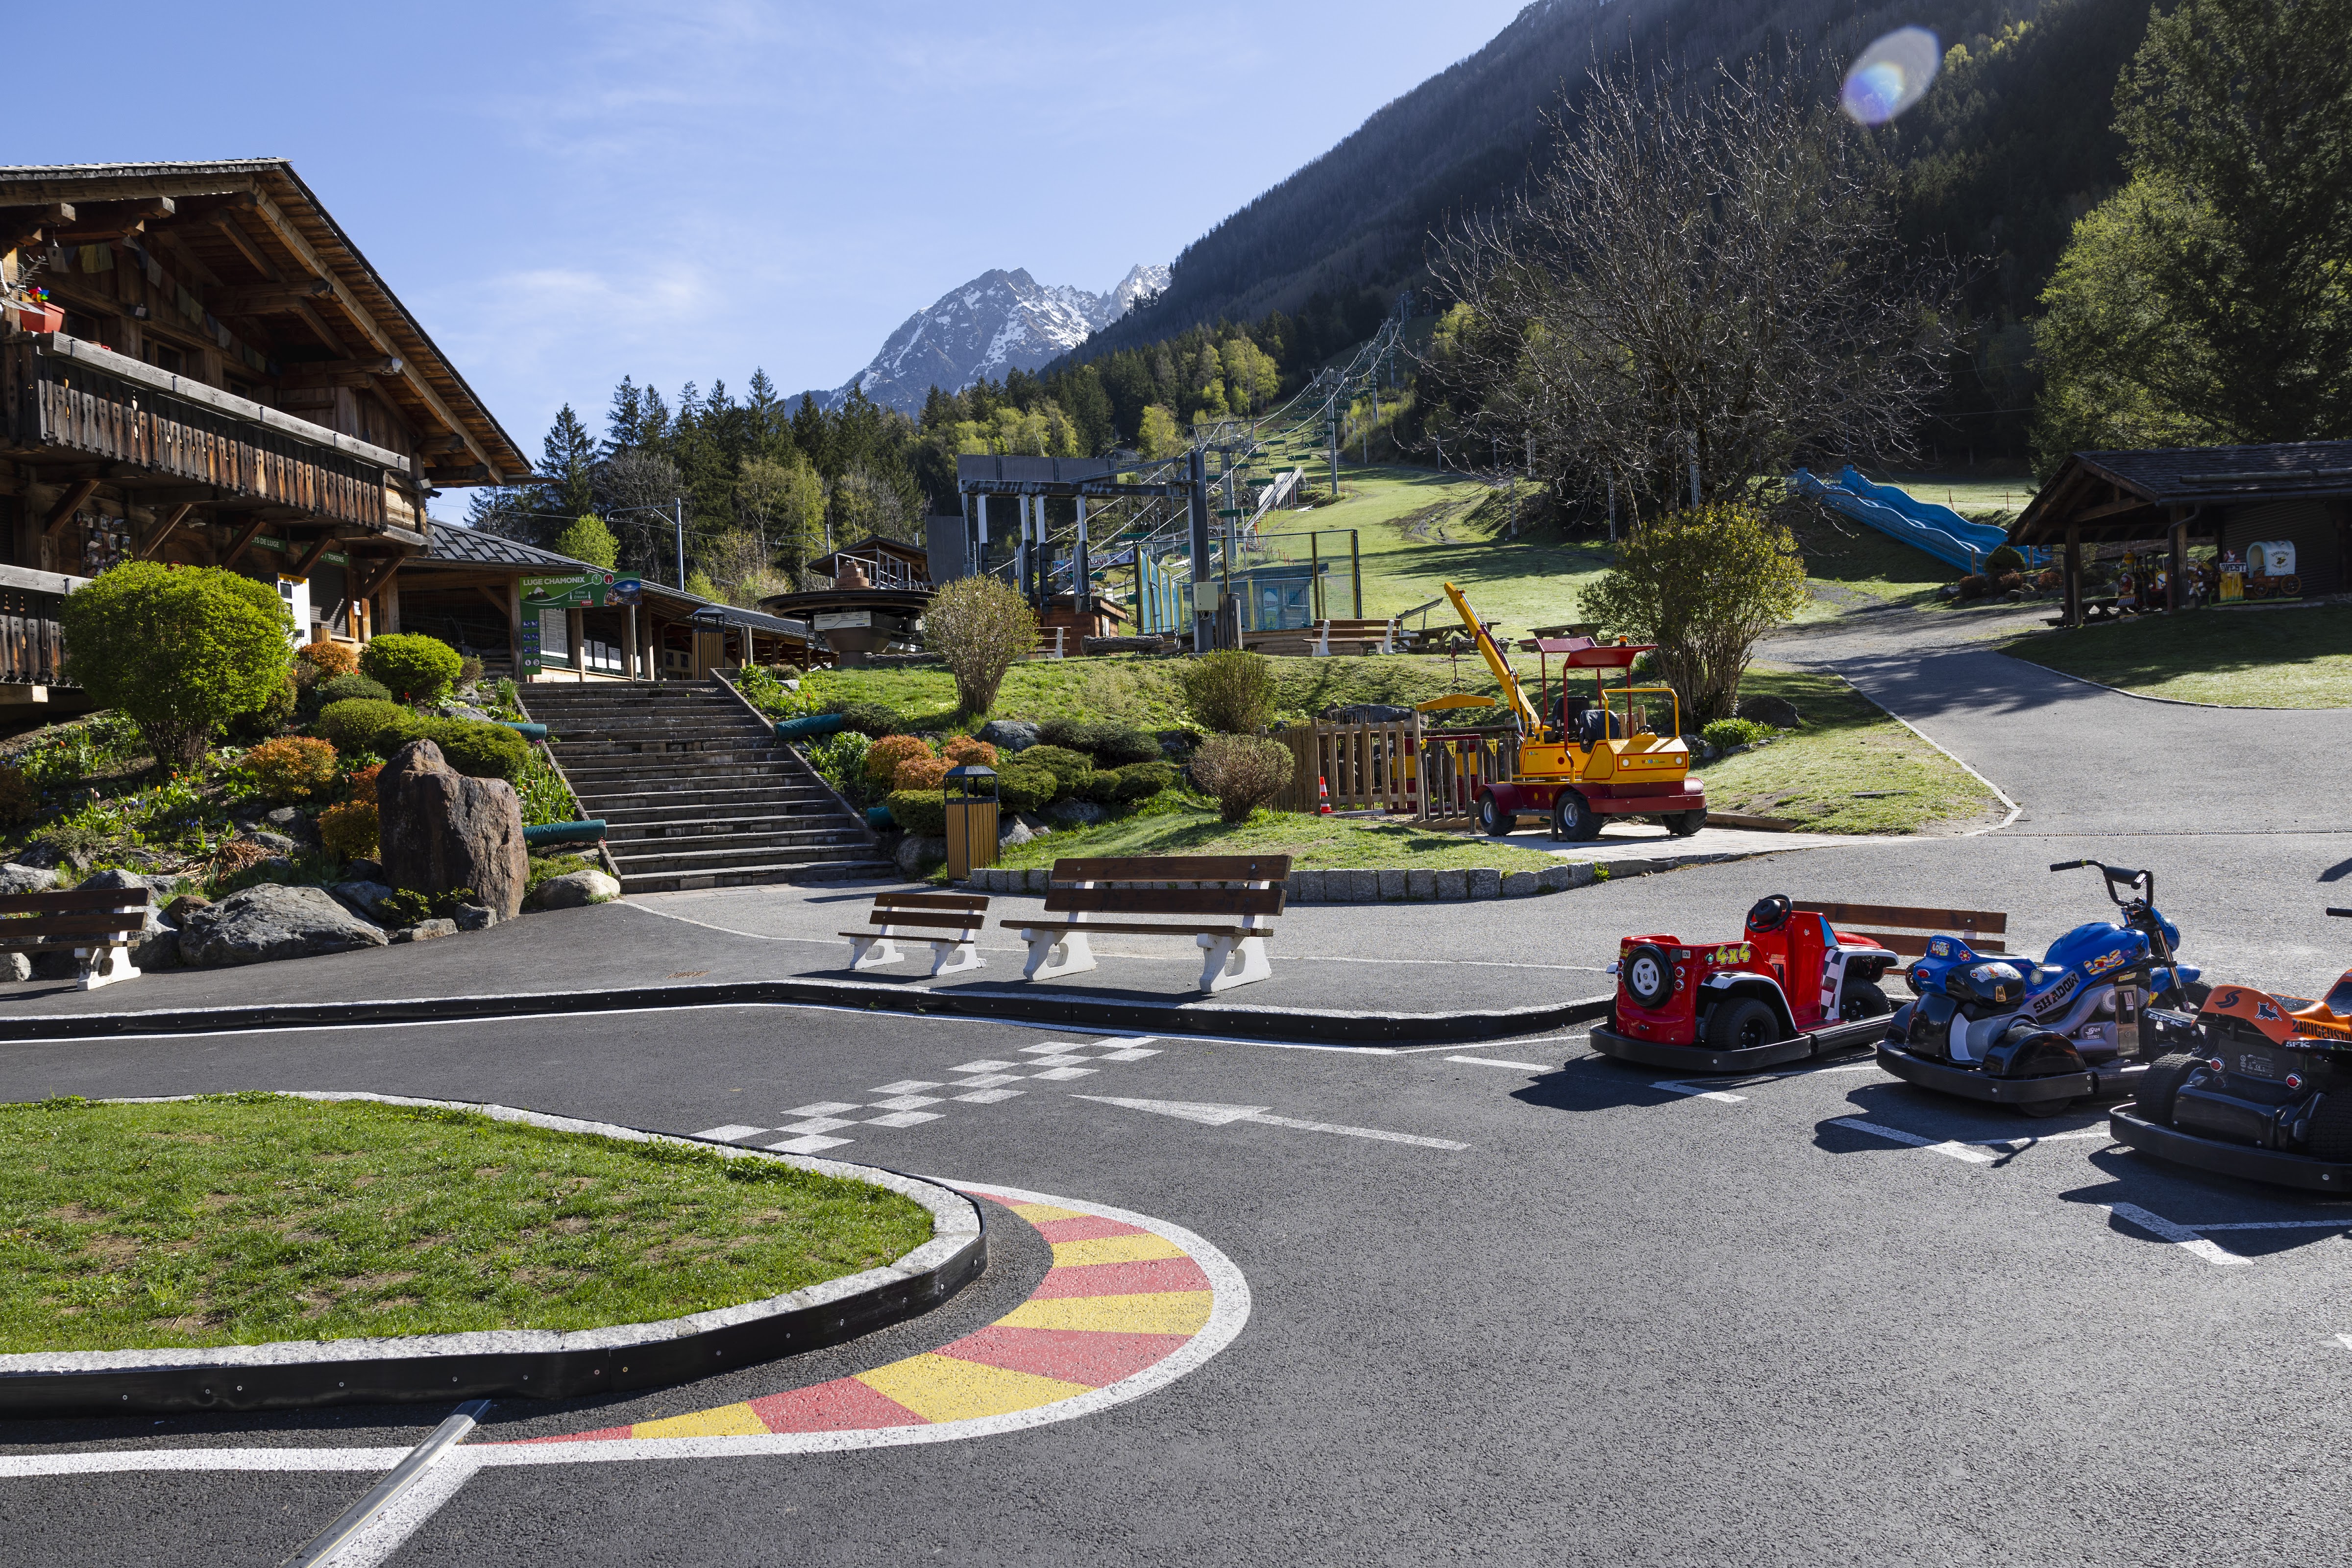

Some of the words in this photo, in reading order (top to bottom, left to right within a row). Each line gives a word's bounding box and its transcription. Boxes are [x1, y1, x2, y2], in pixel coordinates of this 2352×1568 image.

[267, 539, 279, 548] LUGE
[327, 554, 344, 563] TOKENS
[1932, 943, 1947, 953] LOVE
[2083, 949, 2125, 975] LOVE
[2033, 973, 2079, 1013] SHADOW
[2148, 1013, 2182, 1027] SFK
